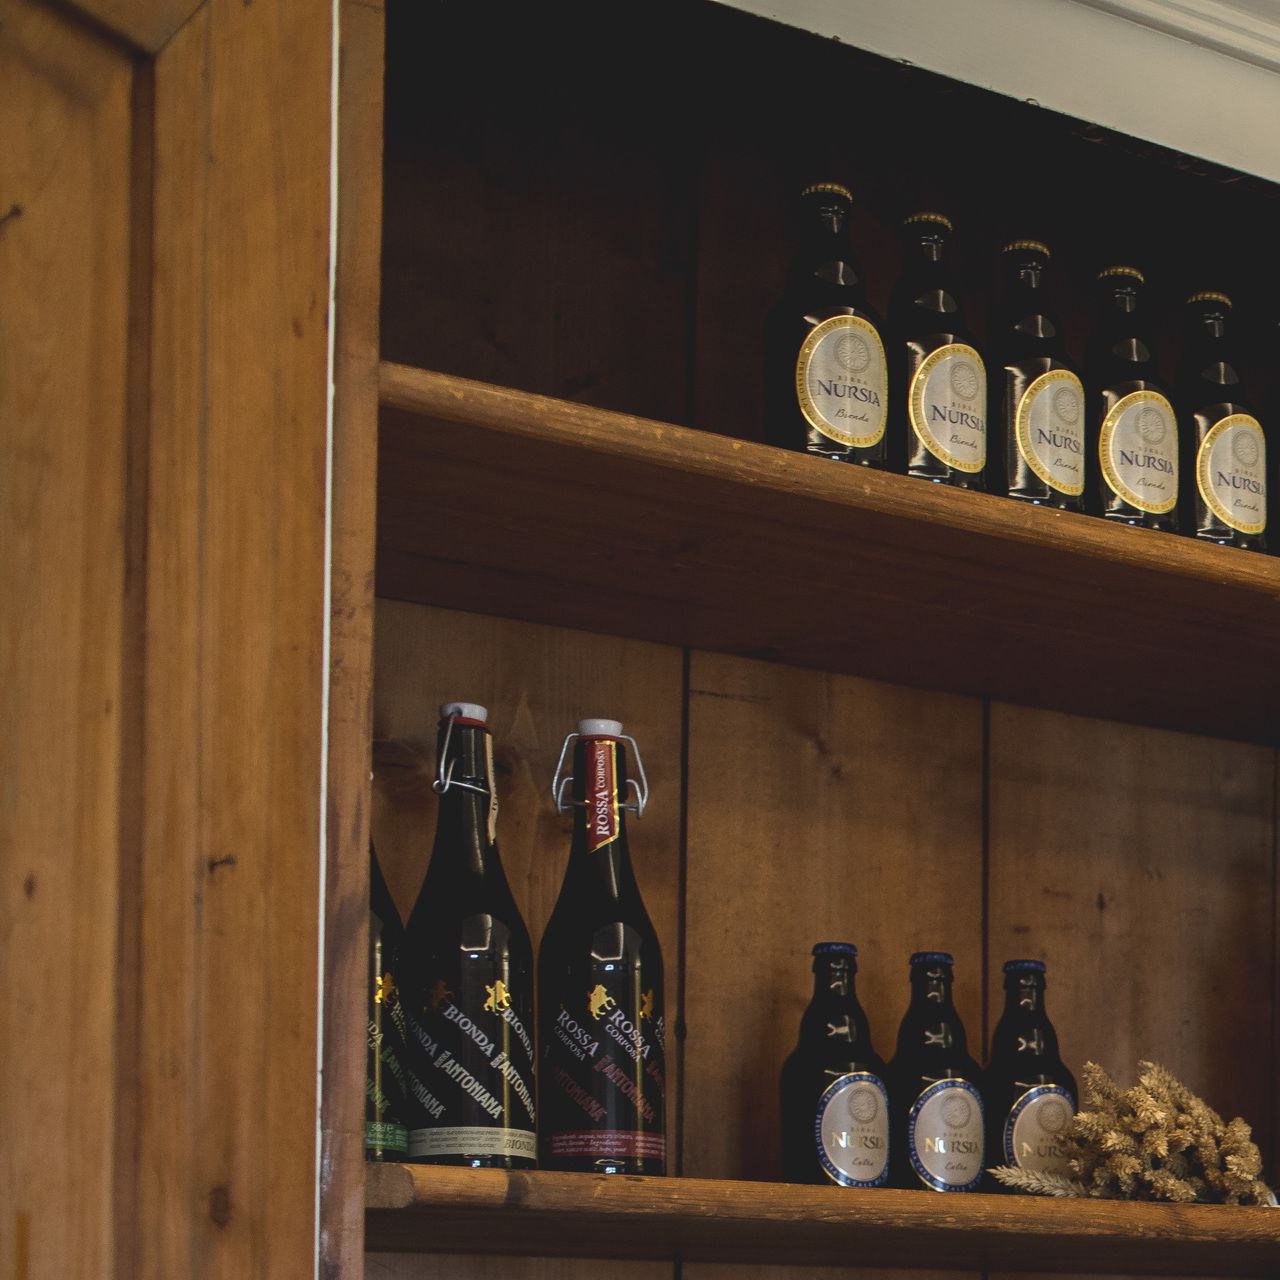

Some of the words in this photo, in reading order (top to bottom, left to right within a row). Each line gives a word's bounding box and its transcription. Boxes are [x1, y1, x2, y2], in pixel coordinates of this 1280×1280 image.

[816, 379, 881, 408] NURSIA
[931, 403, 985, 435] NURSIA
[1119, 449, 1175, 477] NURSIA
[595, 789, 611, 837] ROSSA
[442, 1003, 497, 1058] BIONDA
[553, 1025, 587, 1062] CORPOSA
[556, 1008, 601, 1058] ROSSA
[604, 1022, 642, 1063] CORPOSA
[608, 1008, 652, 1061] ROSSA
[406, 1069, 447, 1120] TONIANA
[440, 1058, 505, 1120] ANTONIANA
